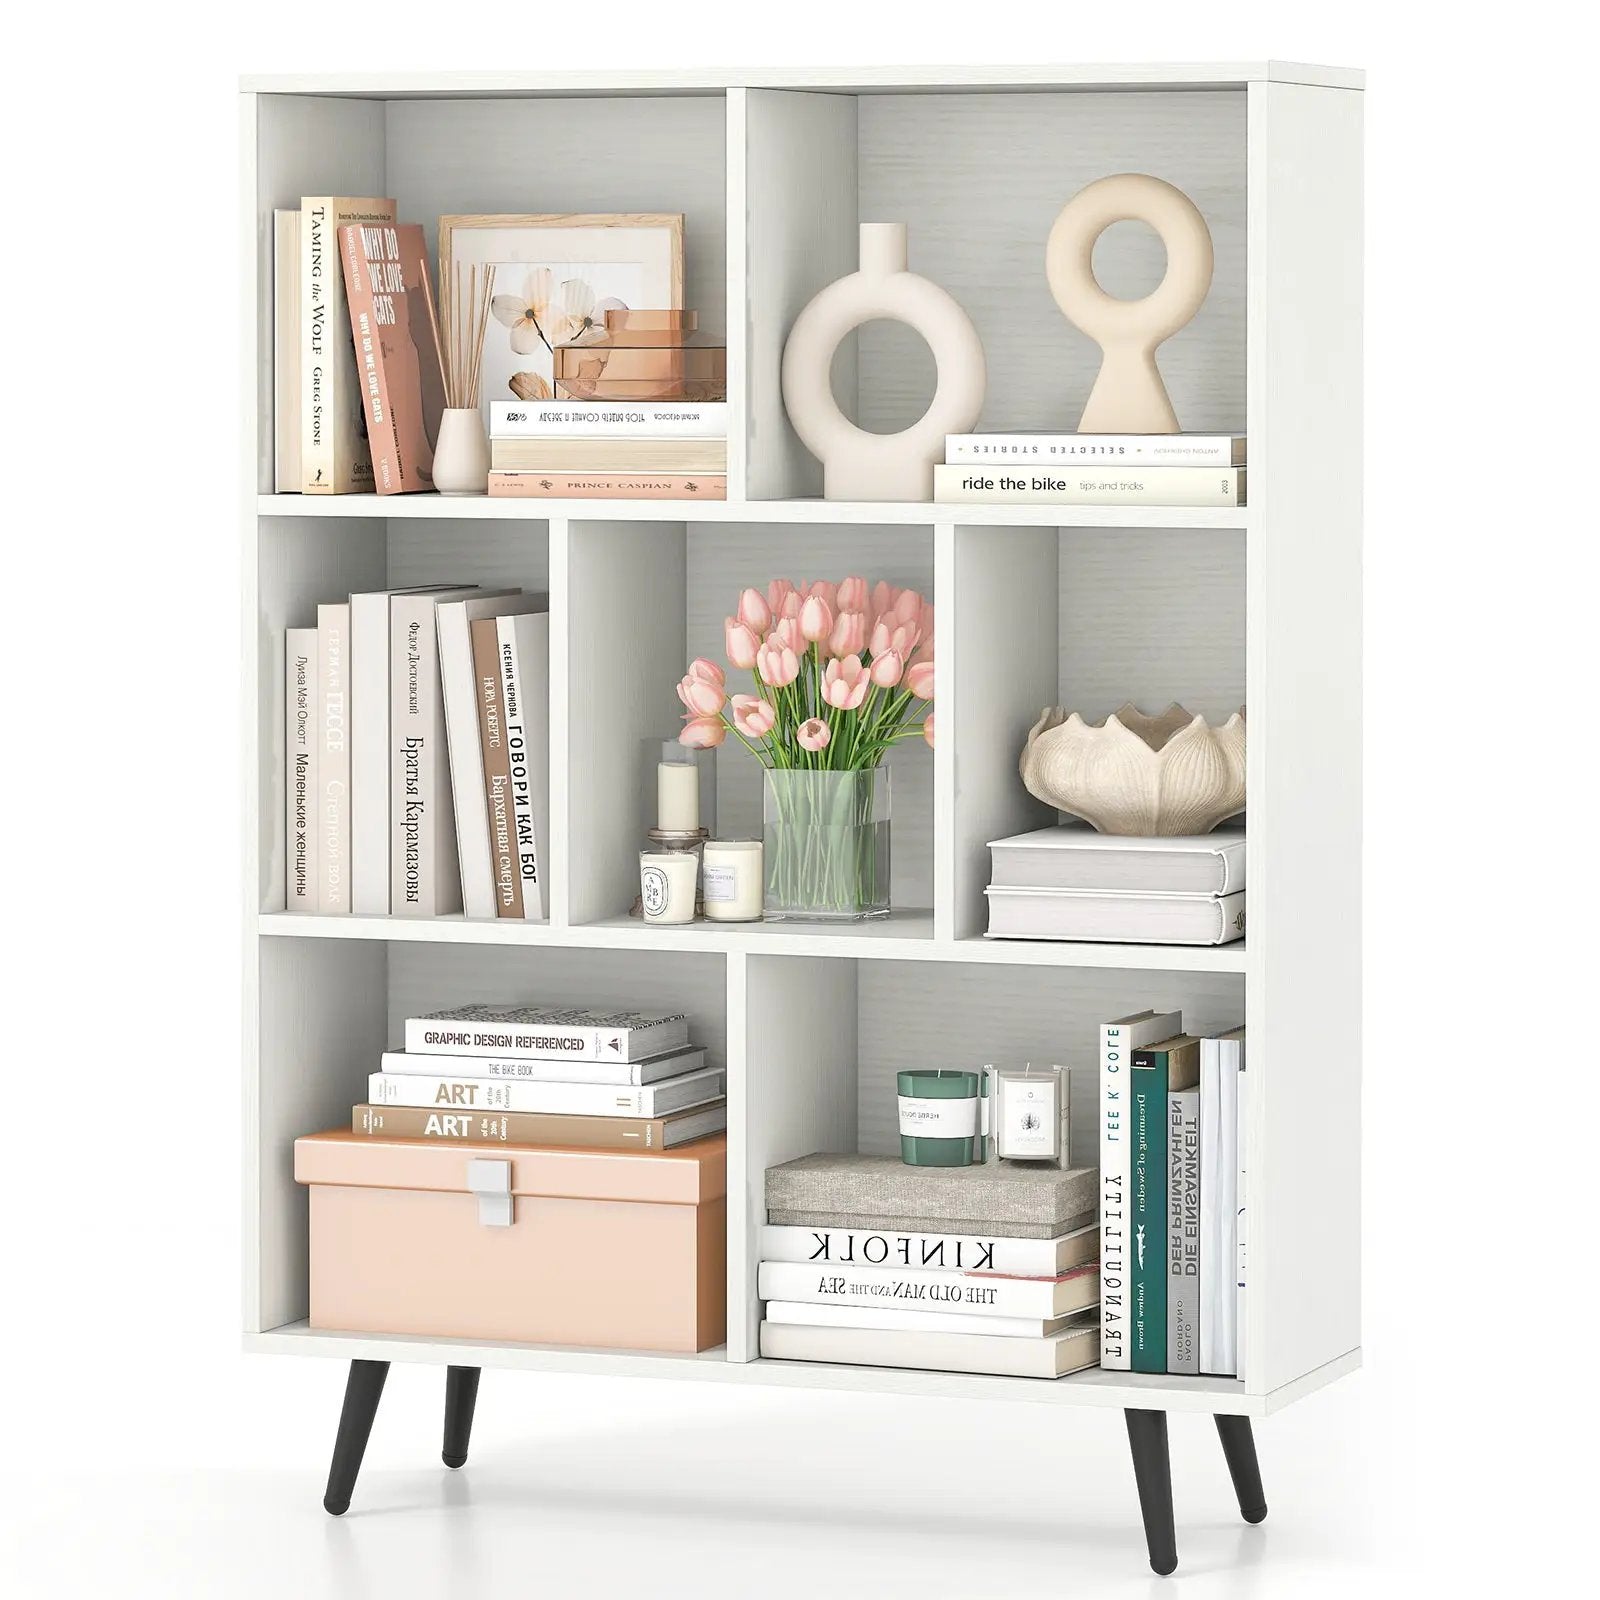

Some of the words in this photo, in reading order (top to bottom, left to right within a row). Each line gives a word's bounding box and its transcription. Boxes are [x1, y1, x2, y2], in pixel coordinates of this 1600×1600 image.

[360, 227, 384, 260] WHY
[386, 227, 399, 260] DO
[366, 262, 382, 293] WE
[383, 262, 405, 293] LOVE
[312, 283, 323, 301] the
[373, 295, 396, 326] CATS
[359, 312, 370, 340] WHY
[363, 340, 372, 354] DO
[365, 354, 375, 370] WE
[367, 370, 379, 396] LOVE
[371, 396, 383, 424] CATS
[973, 445, 1038, 454] STORIES
[1050, 446, 1125, 454] SELECTED
[962, 476, 994, 490] ride
[999, 476, 1026, 491] the
[1031, 477, 1066, 491] bike
[1079, 481, 1096, 492] tips
[1098, 481, 1118, 491] and
[1120, 481, 1144, 491] tricks
[297, 655, 308, 685] Луиза
[503, 643, 514, 680] КСЕНИЯ
[297, 686, 308, 710] Мэй
[483, 677, 495, 702] НОРА
[506, 682, 518, 718] ЧЕРНОВА
[298, 711, 307, 745] Олкотт
[326, 691, 344, 752] ГЕССЕ
[486, 702, 502, 749] РОБЕРТС
[400, 737, 424, 796] Братья
[508, 725, 530, 803] ГОВОРИ
[296, 753, 309, 829] Маленькие
[489, 774, 510, 853] Бархатная
[516, 815, 533, 846] КАК
[296, 831, 307, 896] женщины
[400, 800, 424, 903] Карамазовы
[498, 855, 515, 907] смерть
[520, 853, 537, 884] БОГ
[424, 1031, 471, 1047] GRAPHIC
[473, 1033, 513, 1048] DESIGN
[515, 1035, 585, 1051] REFERENCED
[488, 1063, 501, 1075] THE
[501, 1064, 515, 1076] BIKE
[517, 1064, 533, 1076] BOOK
[434, 1083, 479, 1105] ART
[503, 1084, 511, 1109] Century
[424, 1113, 473, 1137] ART
[482, 1128, 489, 1137] of
[500, 1116, 509, 1141] Century
